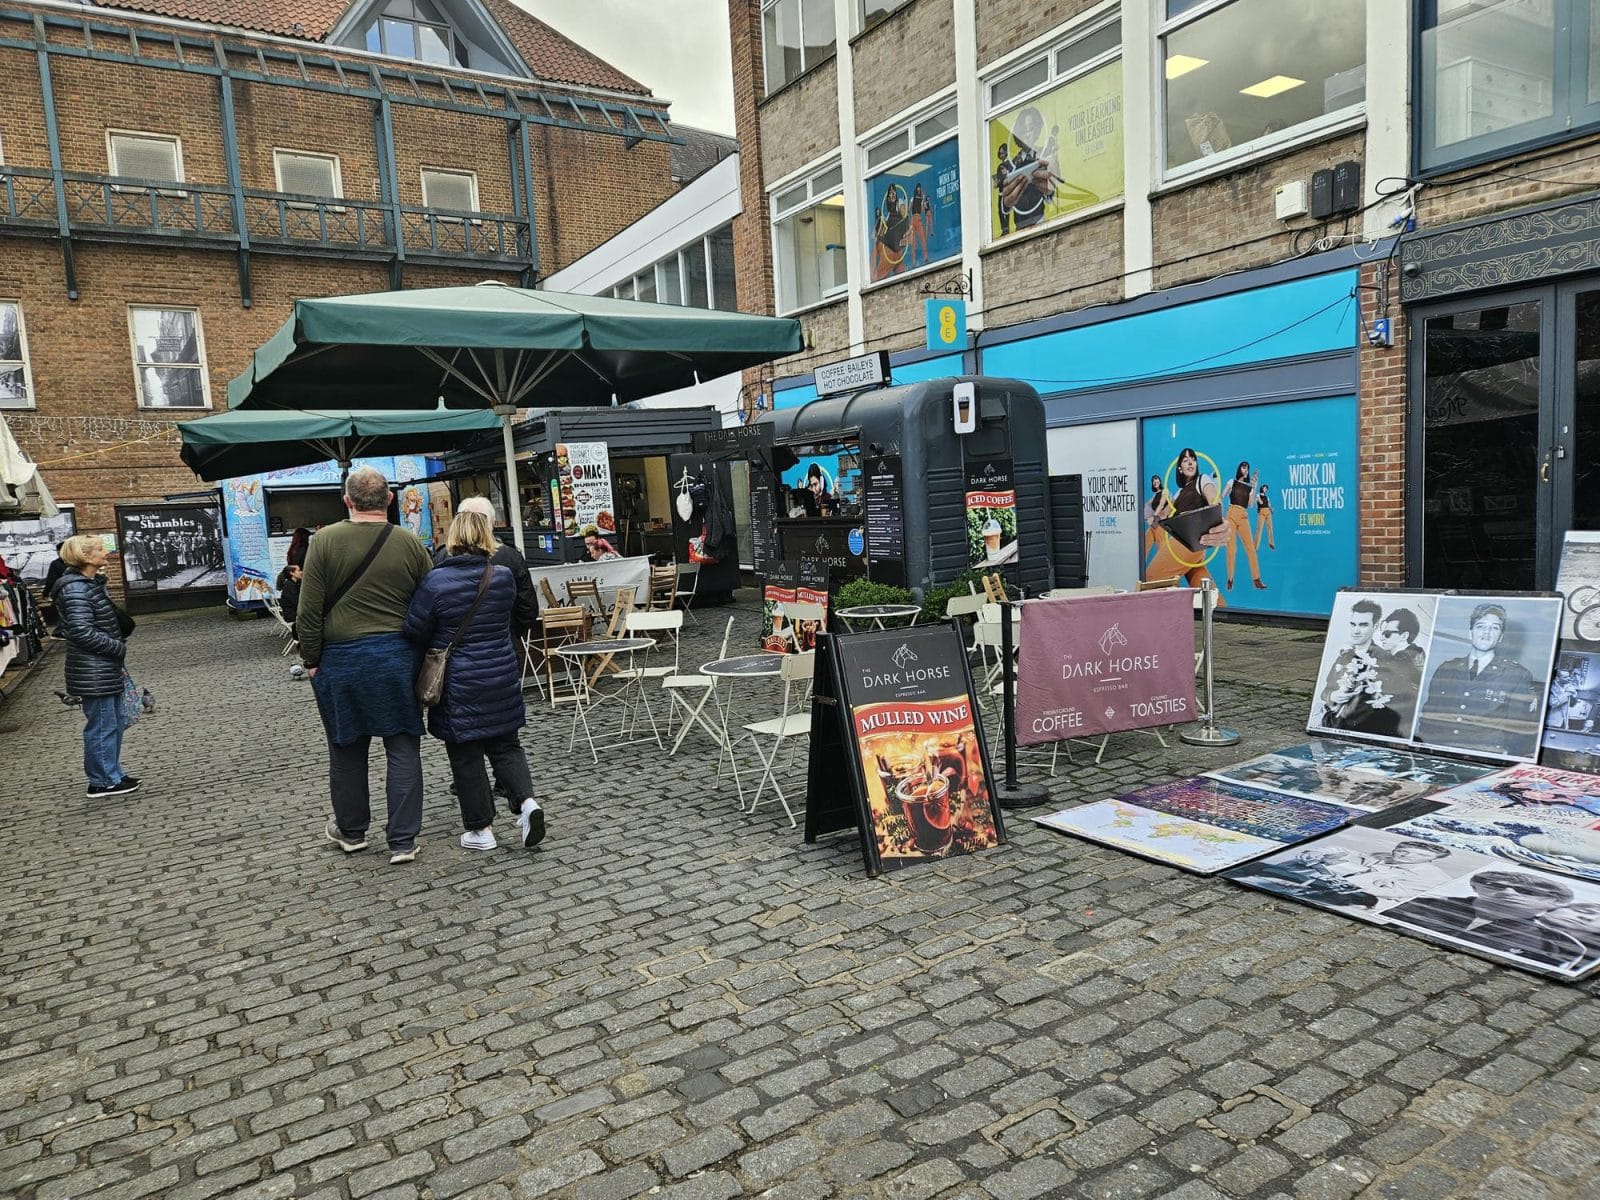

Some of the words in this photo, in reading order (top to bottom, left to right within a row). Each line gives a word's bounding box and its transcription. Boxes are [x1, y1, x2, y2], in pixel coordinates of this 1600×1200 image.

[1087, 95, 1121, 124] LEARNING
[1076, 116, 1114, 146] UNLEASHED
[821, 366, 845, 380] COFFEE
[847, 358, 874, 373] BAILEYS
[823, 379, 836, 389] HOT
[836, 370, 875, 387] CHOCOLATE
[704, 431, 717, 441] THE
[738, 424, 761, 437] HORSE
[583, 463, 602, 480] MAC
[971, 477, 987, 485] DARK
[988, 474, 1008, 483] HORSE
[1289, 463, 1320, 486] WORK
[1321, 462, 1336, 485] ON
[1087, 476, 1107, 493] YOUR
[1108, 474, 1129, 493] HOME
[967, 495, 986, 505] ICED
[986, 495, 1014, 505] COFFEE
[1082, 495, 1100, 512] RUNS
[1101, 494, 1136, 513] SMARTER
[1281, 487, 1308, 510] YOUR
[1309, 486, 1345, 509] TERMS
[140, 517, 195, 529] Shambles
[1307, 513, 1326, 526] WORK
[822, 557, 847, 567] HORSE
[863, 672, 901, 688] DARK
[905, 665, 951, 683] HORSE
[1062, 660, 1103, 679] DARK
[1109, 654, 1159, 673] HORSE
[1129, 697, 1187, 718] TOASTIES
[860, 711, 925, 733] MULLED
[927, 704, 968, 725] WINE
[1032, 711, 1084, 733] COFFEE
